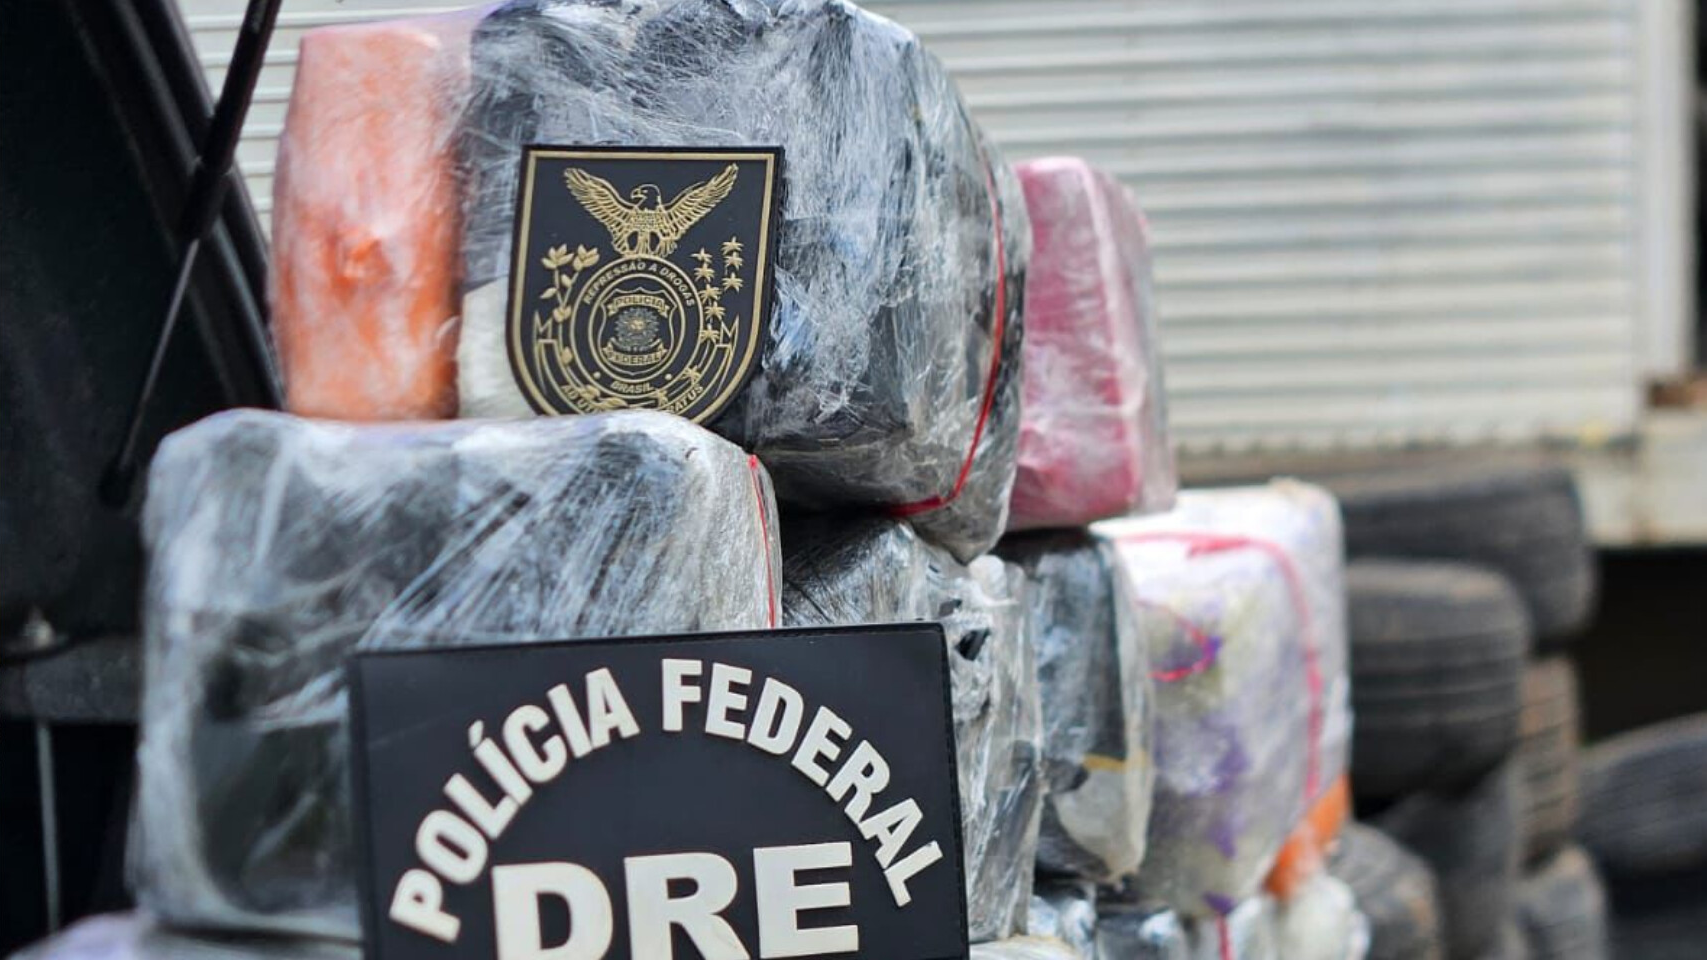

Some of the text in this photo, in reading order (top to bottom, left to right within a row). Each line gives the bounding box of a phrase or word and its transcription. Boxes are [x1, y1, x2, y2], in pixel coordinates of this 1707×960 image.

[659, 267, 695, 306] DROGAS
[610, 380, 653, 394] BRASIL
[389, 658, 944, 943] POLÍCIA FEDERAL
